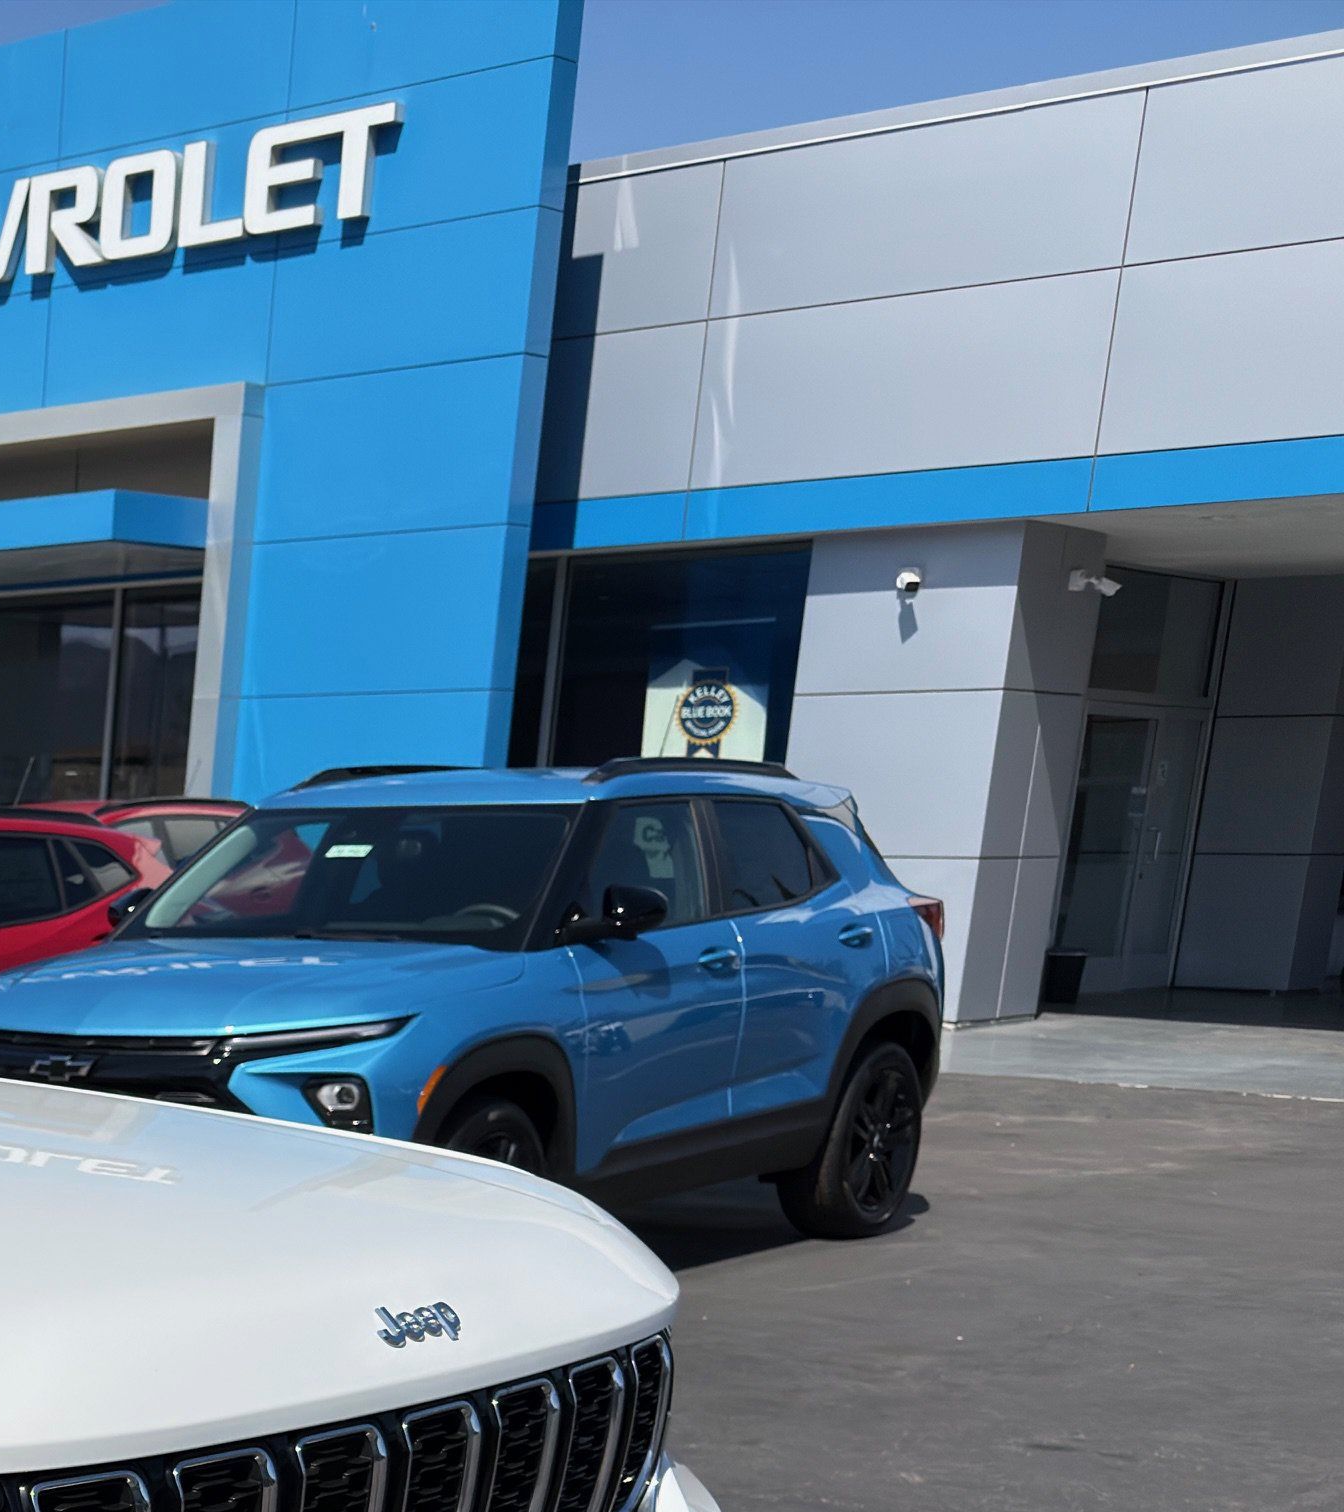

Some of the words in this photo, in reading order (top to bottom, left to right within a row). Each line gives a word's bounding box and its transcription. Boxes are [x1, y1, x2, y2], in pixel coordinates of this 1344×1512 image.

[688, 685, 731, 704] KELLEY
[680, 706, 705, 719] BLUE
[706, 705, 732, 718] BOOK
[374, 1301, 461, 1349] Jeep
